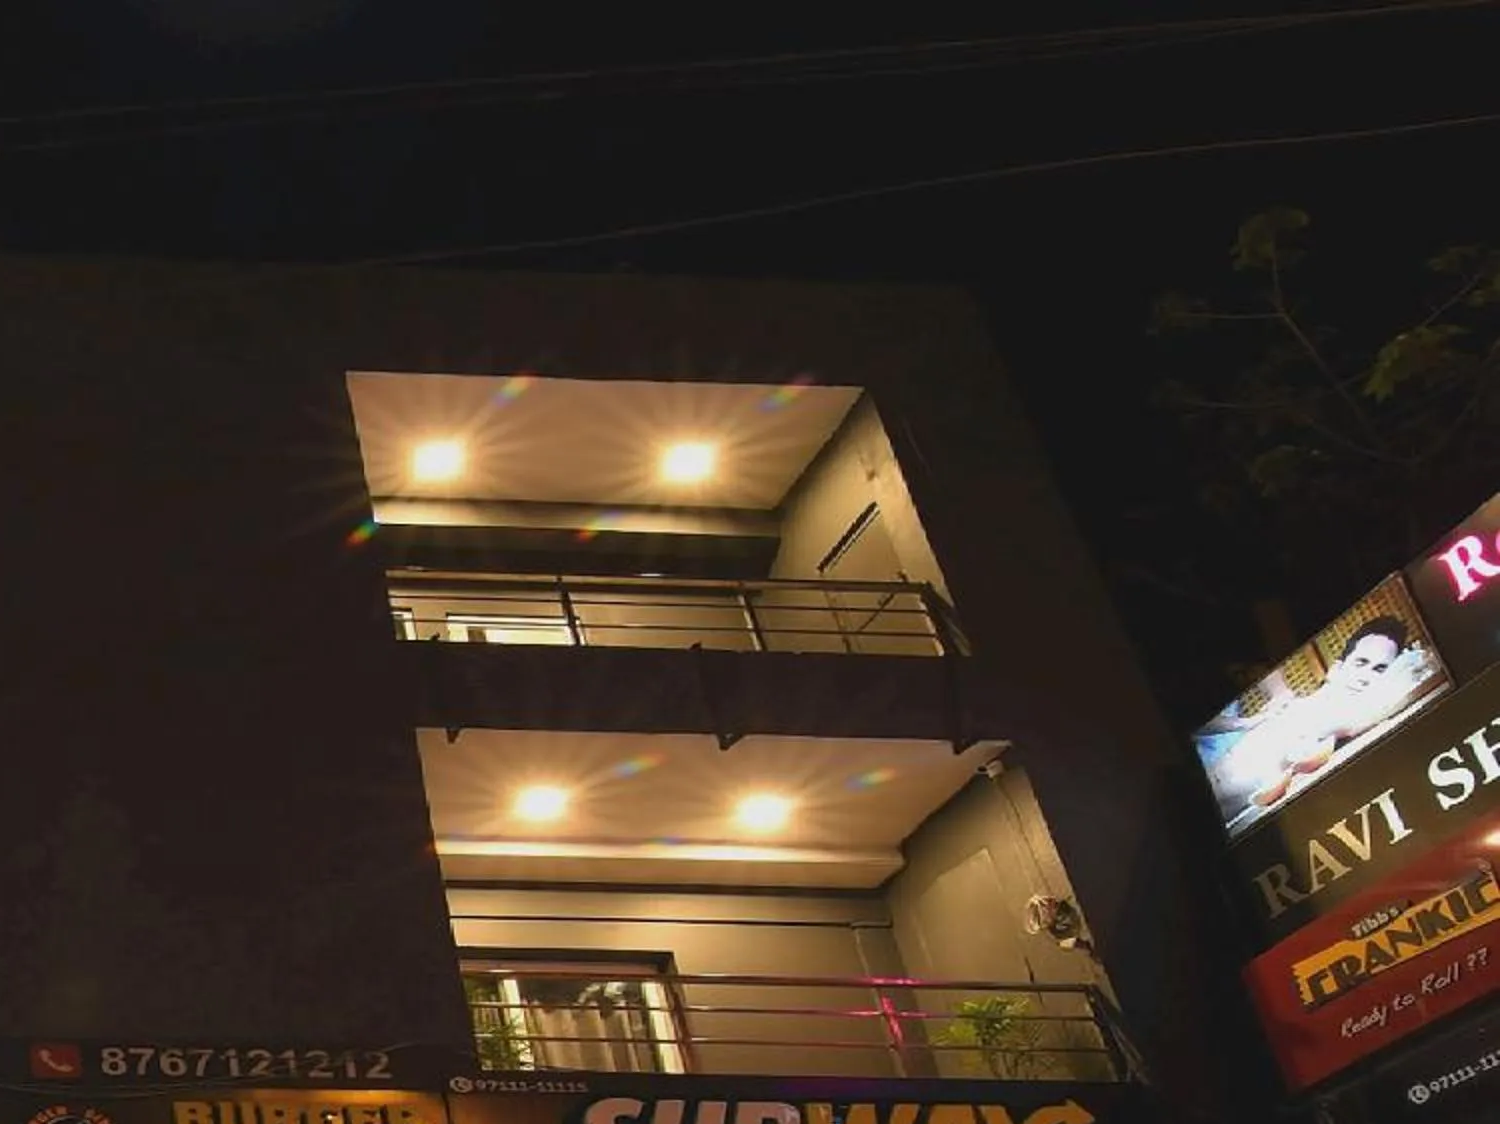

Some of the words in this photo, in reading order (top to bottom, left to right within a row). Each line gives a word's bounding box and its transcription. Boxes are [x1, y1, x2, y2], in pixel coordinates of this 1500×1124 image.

[1437, 534, 1500, 601] R
[1252, 787, 1414, 919] RAVI
[1420, 960, 1461, 995] Roll
